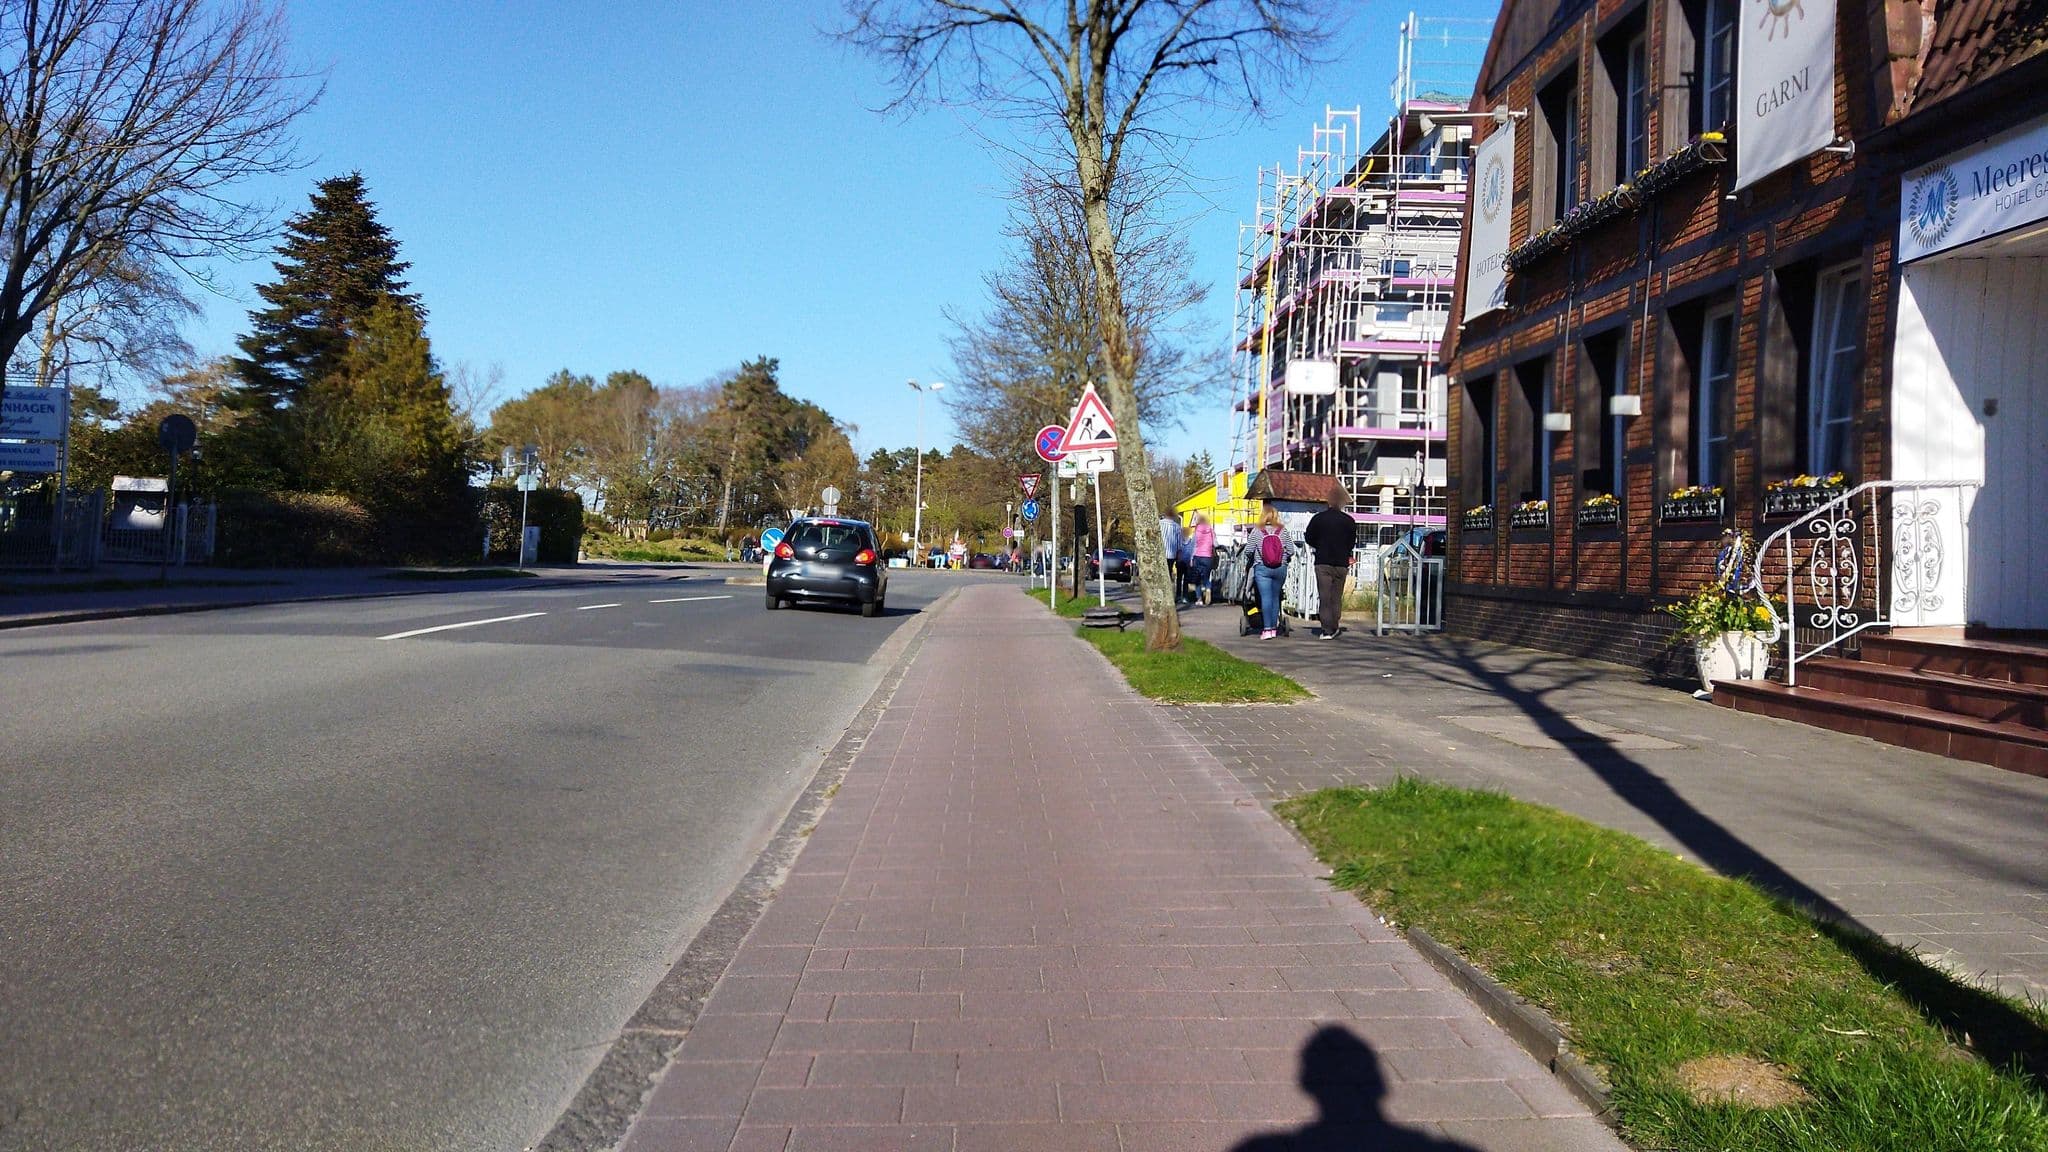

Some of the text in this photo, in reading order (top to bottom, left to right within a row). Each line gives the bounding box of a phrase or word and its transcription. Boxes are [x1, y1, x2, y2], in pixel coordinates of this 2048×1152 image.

[1756, 66, 1809, 117] GARNI
[1995, 188, 2032, 213] HOTEL
[1475, 253, 1499, 278] HOTEL
[2, 402, 55, 414] NHAGEN
